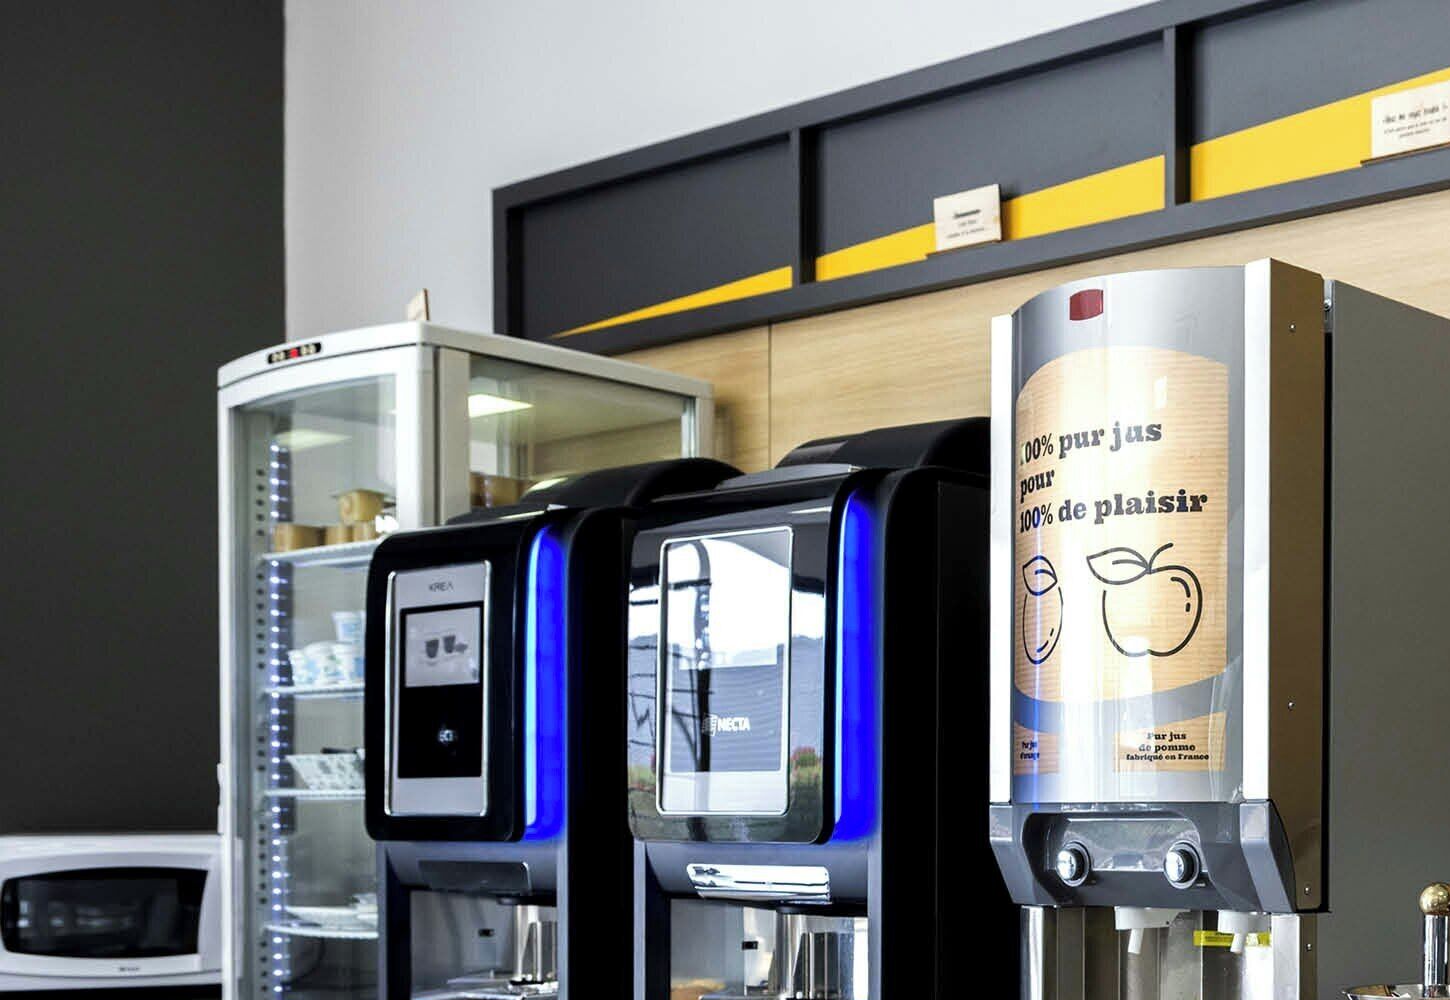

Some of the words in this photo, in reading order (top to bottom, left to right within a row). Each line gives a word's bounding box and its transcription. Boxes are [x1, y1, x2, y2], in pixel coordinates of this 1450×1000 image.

[1058, 428, 1105, 459] pur
[1109, 421, 1162, 452] jus
[1020, 469, 1055, 504] pour
[1020, 503, 1054, 533] 100%
[1058, 499, 1087, 523] de
[1094, 489, 1208, 525] plaisir
